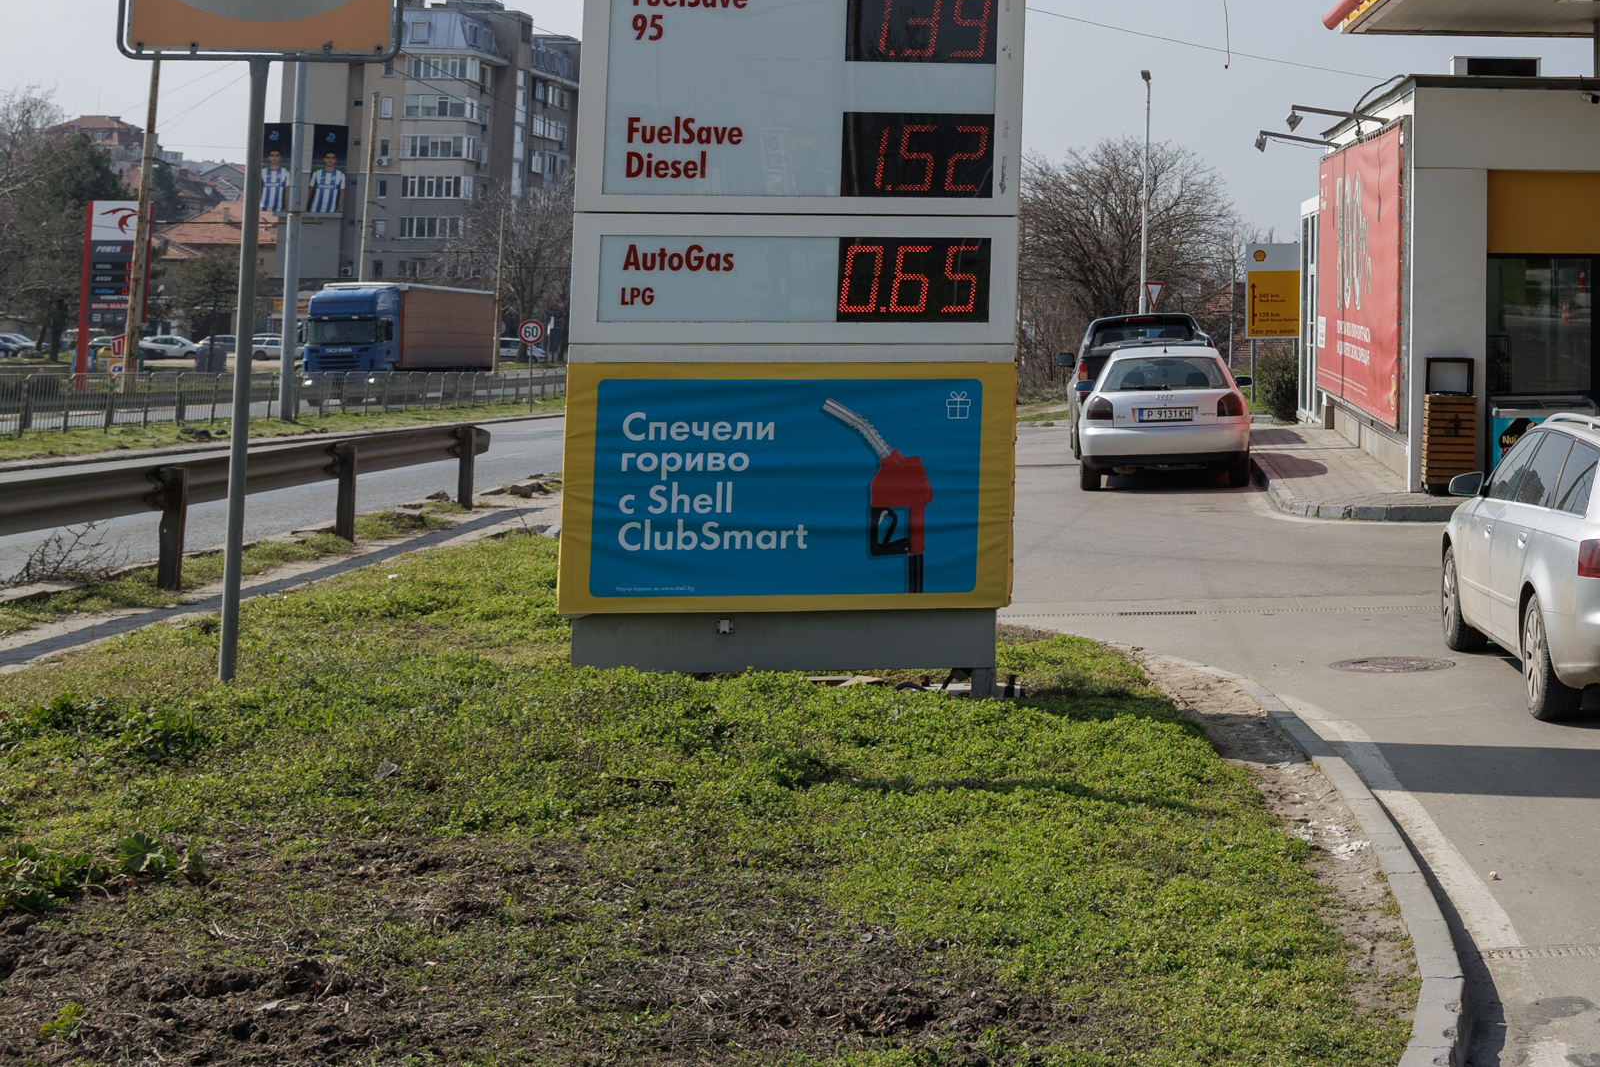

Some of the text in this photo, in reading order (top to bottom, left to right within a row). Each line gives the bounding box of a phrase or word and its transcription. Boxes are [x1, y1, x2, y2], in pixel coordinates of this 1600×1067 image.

[631, 14, 664, 41] 95
[626, 115, 743, 146] FuelSave
[625, 151, 707, 179] Diesel
[874, 125, 989, 192] 1.52
[622, 244, 734, 272] AutoGas
[839, 245, 978, 313] 0.65
[620, 287, 655, 306] LPG
[524, 325, 539, 338] 60
[622, 411, 775, 441] Спечели
[1147, 410, 1153, 419] P
[620, 450, 750, 480] гориво
[619, 482, 733, 515] с Shell
[618, 521, 808, 552] ClubSmart
